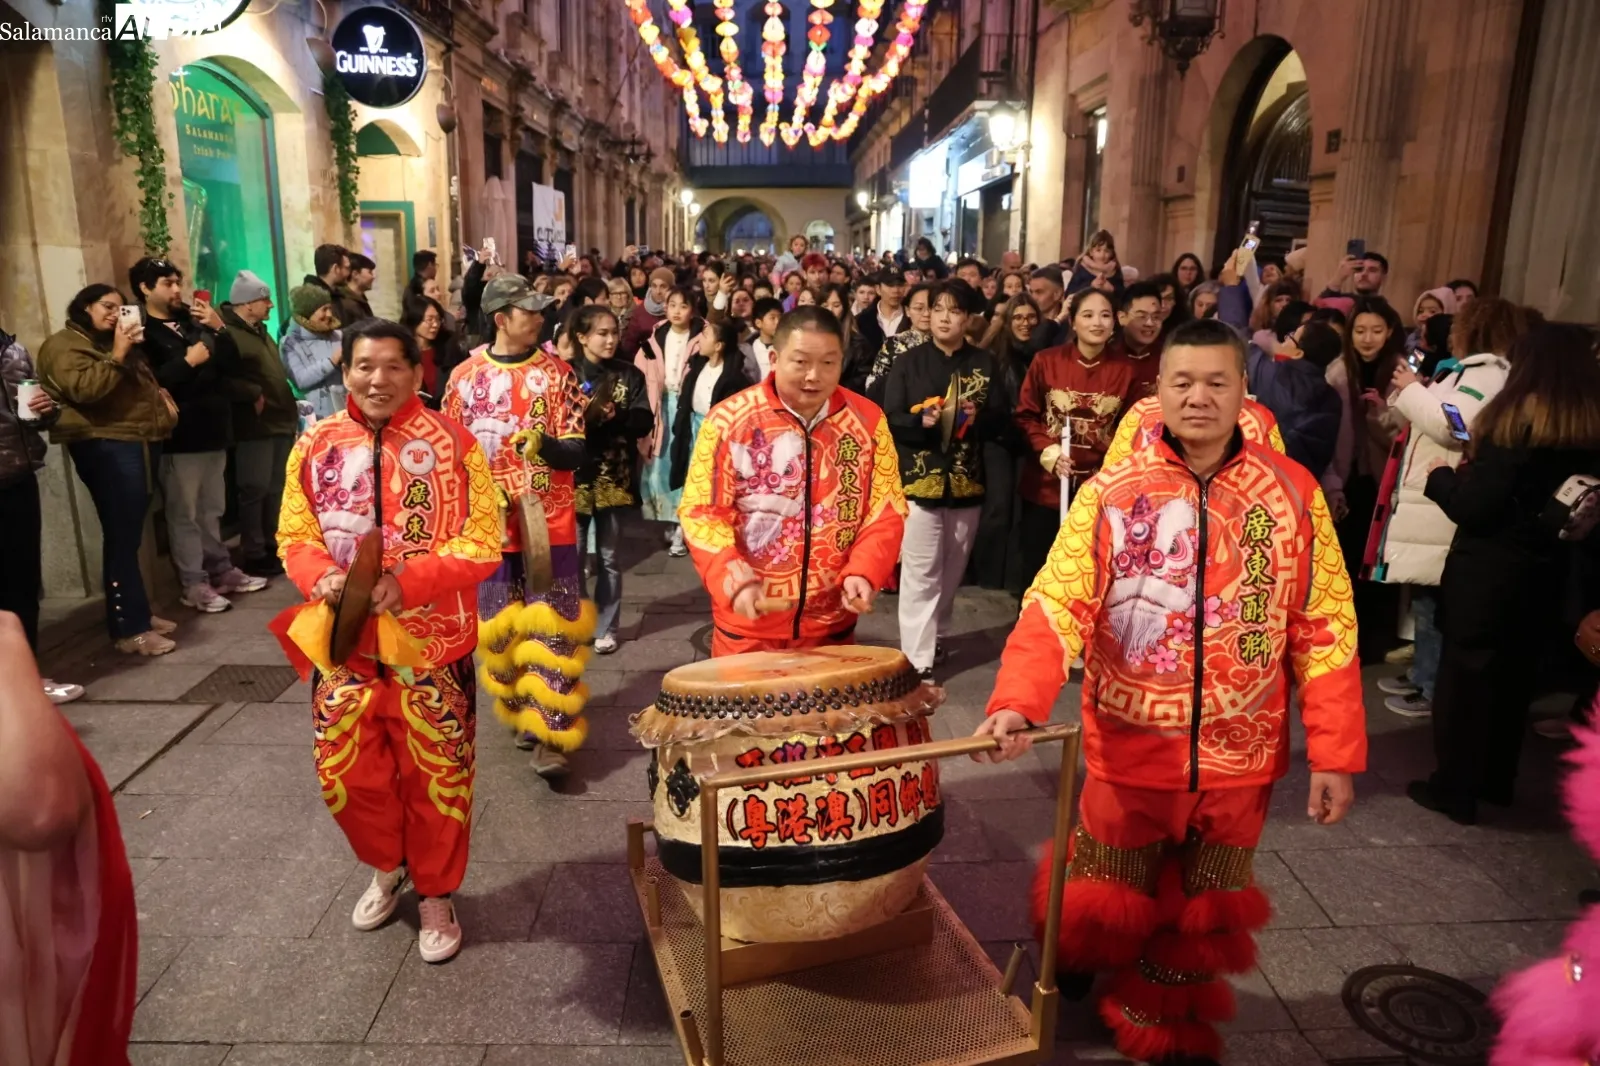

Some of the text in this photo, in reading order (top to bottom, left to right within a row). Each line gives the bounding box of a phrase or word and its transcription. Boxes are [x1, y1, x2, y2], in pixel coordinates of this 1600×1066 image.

[336, 50, 418, 77] GUINNESS
[402, 478, 433, 561] 廣東
[1238, 504, 1278, 668] 廣東醒獅
